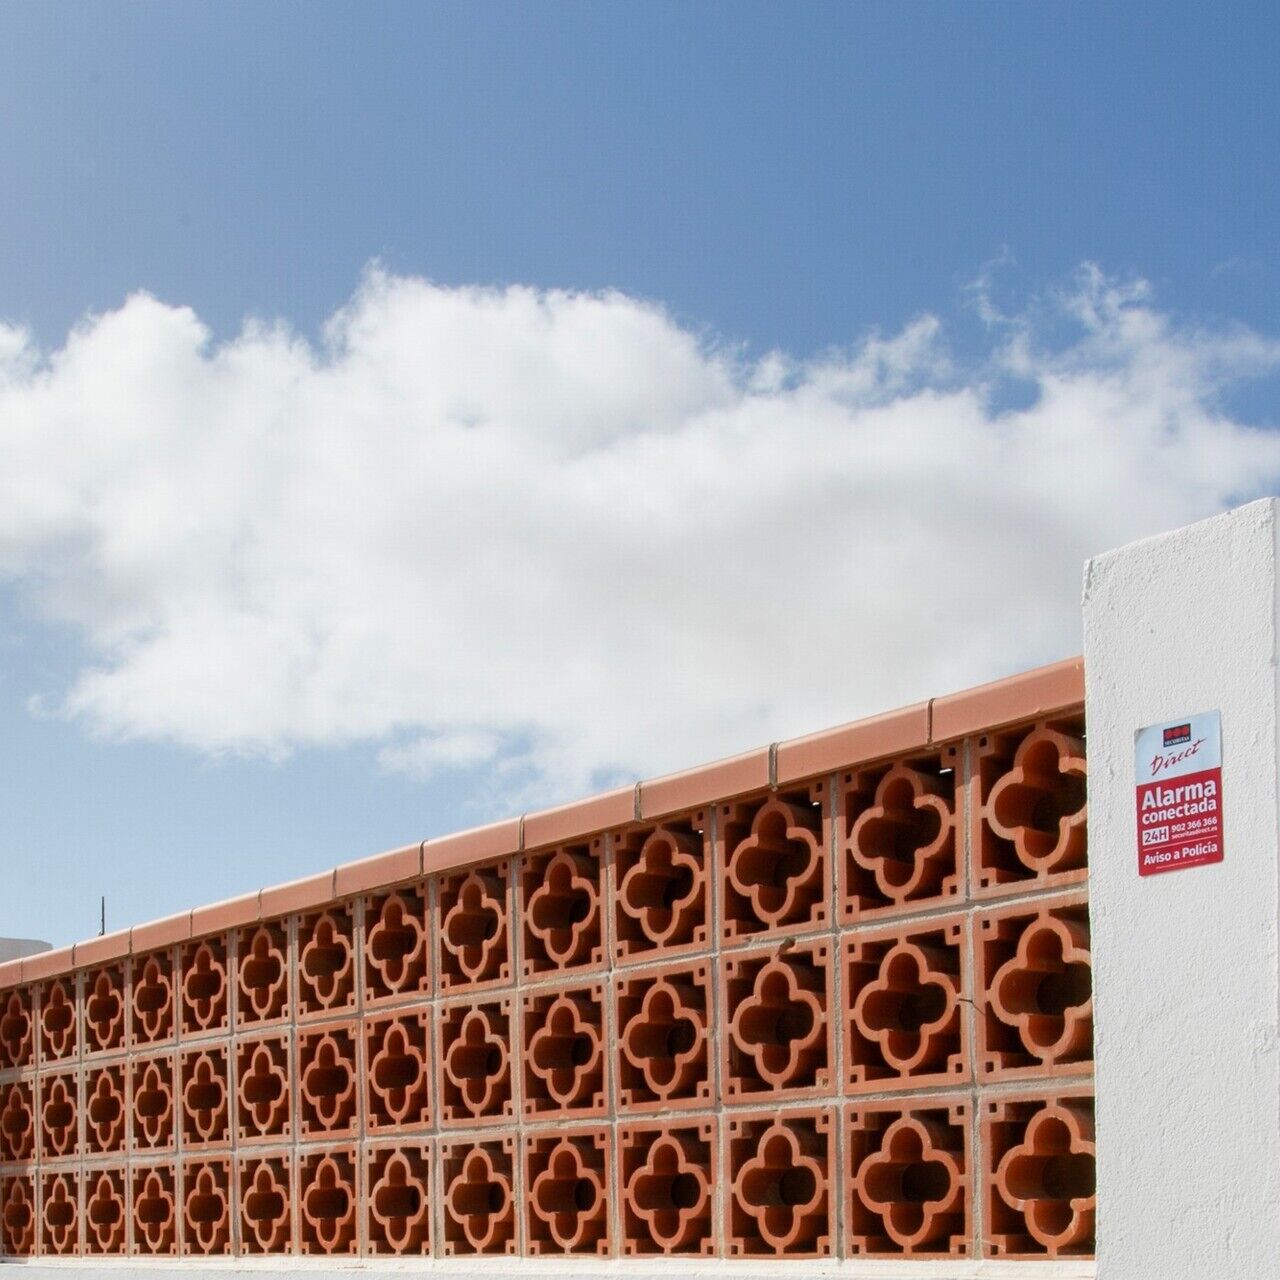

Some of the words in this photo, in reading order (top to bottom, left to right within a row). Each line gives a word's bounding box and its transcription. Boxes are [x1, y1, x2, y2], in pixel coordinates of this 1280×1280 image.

[1150, 738, 1206, 776] Direct
[1142, 780, 1217, 810] Alarma
[1142, 797, 1217, 825] conectada
[1144, 828, 1168, 844] 24H
[1171, 823, 1186, 833] 902
[1203, 816, 1218, 827] 366
[1143, 850, 1171, 866] Aviso
[1173, 849, 1181, 860] a
[1182, 841, 1218, 858] Policía
